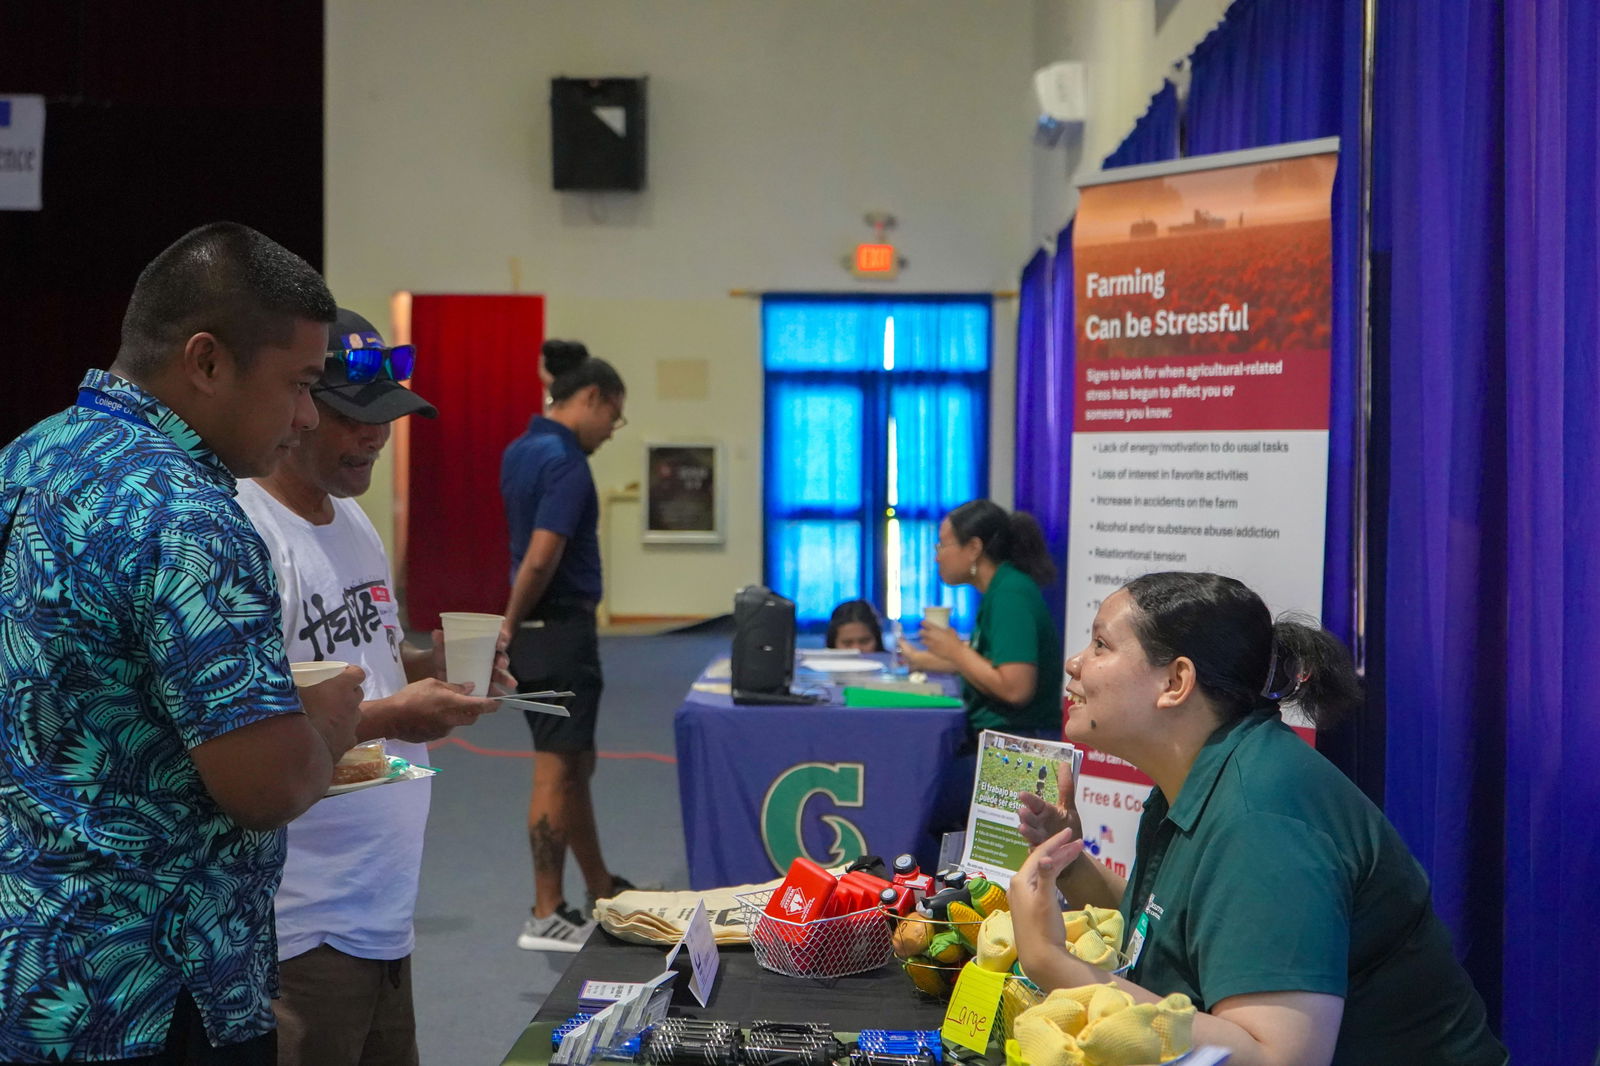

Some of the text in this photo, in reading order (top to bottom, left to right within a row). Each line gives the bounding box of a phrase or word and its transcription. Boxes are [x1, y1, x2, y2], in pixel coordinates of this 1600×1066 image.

[1086, 267, 1165, 299] Farming
[1086, 302, 1249, 341] Can be Stressful
[1087, 360, 1282, 384] Signs to look for when agricultural-related
[1086, 384, 1235, 402] stress has begun to affect you or
[95, 395, 123, 411] College
[1086, 406, 1172, 422] someone you know:
[1098, 441, 1289, 455] Lack of energy/motivation to do usual tasks
[1097, 468, 1248, 481] Loss of interest in favorite activities
[1096, 496, 1238, 509] Increase in accidents on the farm
[1095, 522, 1280, 539] Alcohol and/or substance abuse/addiction
[1153, 551, 1187, 562] tension
[987, 784, 1009, 798] trabajo
[979, 795, 997, 805] puede
[998, 799, 1008, 807] ser
[1083, 787, 1144, 812] Free & Co
[946, 981, 987, 1038] Large
